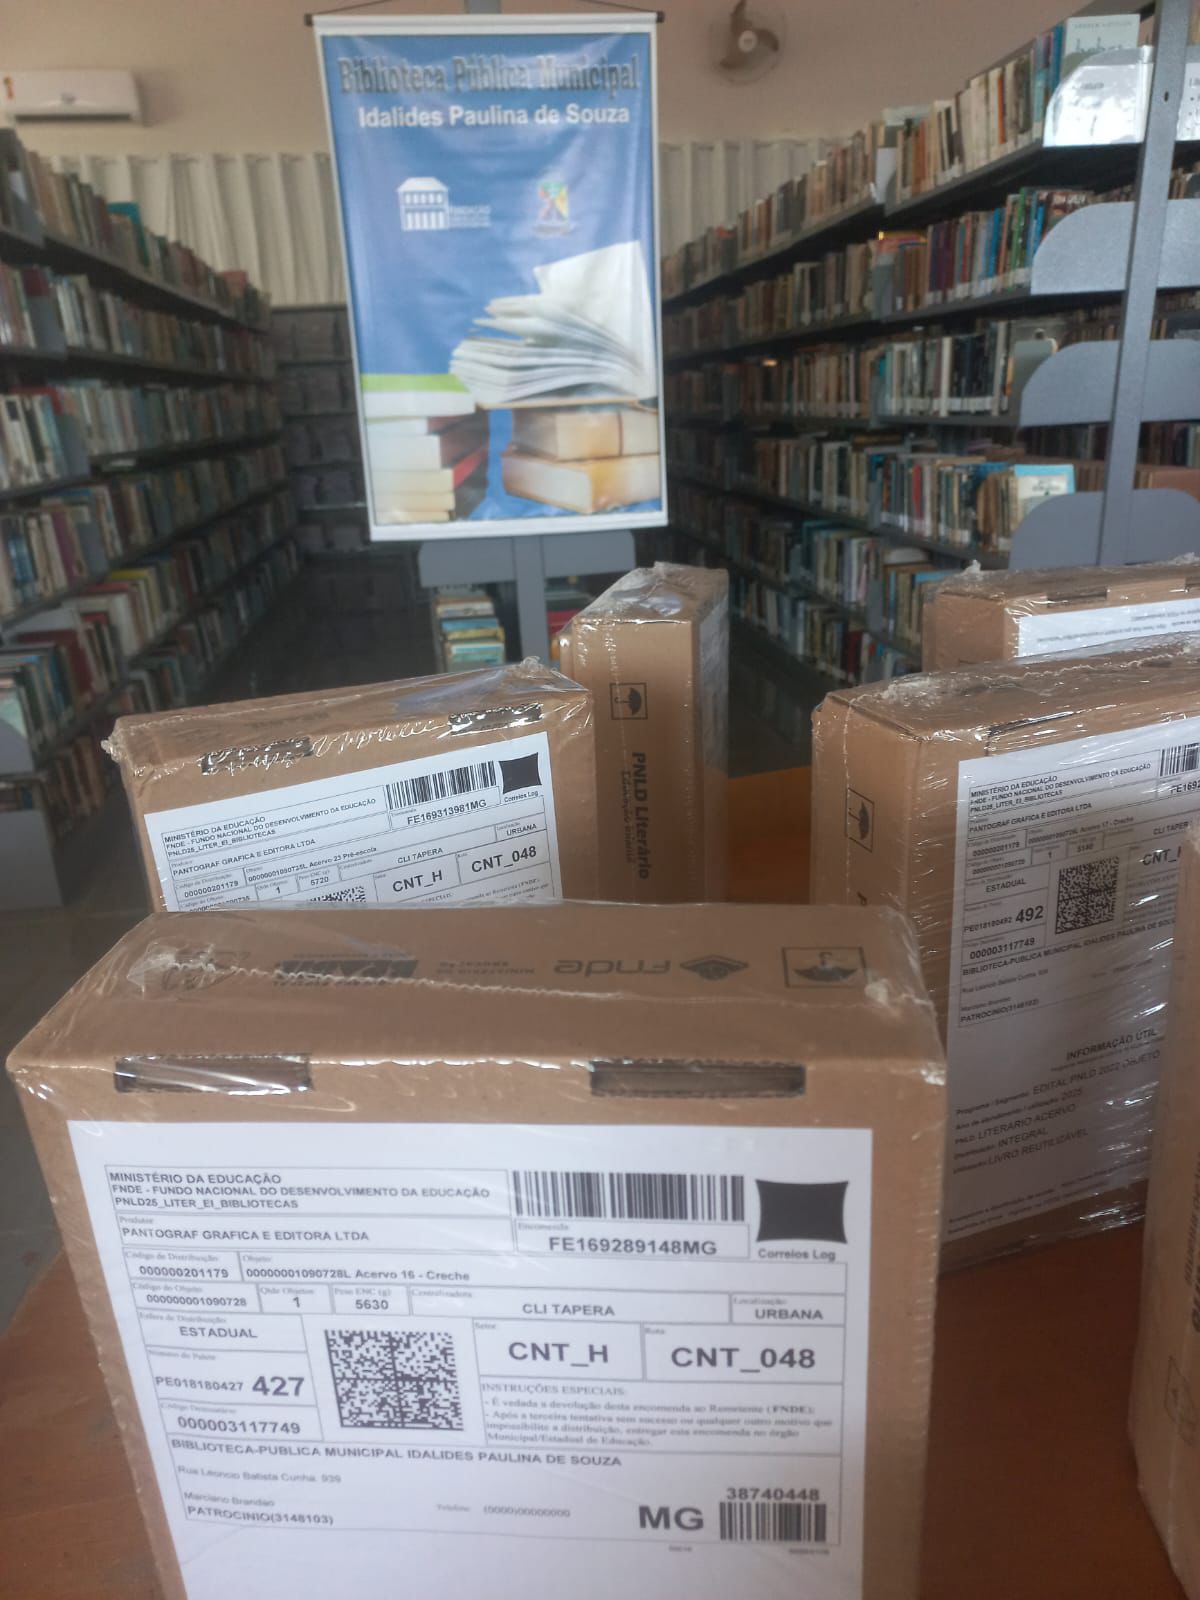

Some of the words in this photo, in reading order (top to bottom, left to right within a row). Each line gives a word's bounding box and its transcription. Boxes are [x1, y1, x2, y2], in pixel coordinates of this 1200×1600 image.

[338, 56, 448, 94] Biblioteca
[454, 54, 532, 93] Pública
[538, 54, 640, 99] Municipal
[359, 106, 443, 128] Idalides
[450, 105, 528, 126] Paulina
[534, 105, 560, 123] de
[566, 104, 630, 123] Souza
[631, 752, 648, 802] PNLD
[503, 791, 526, 803] Correios
[527, 789, 538, 798] Log
[406, 799, 486, 825] FE169313981MG
[164, 827, 209, 843] MINISTÉRIO
[223, 815, 265, 831] EDUCAÇÃO
[191, 834, 215, 844] FUNDO
[216, 826, 252, 838] NACIONAL
[633, 806, 651, 880] Literário
[173, 860, 220, 876] PANTOGRAF
[263, 843, 294, 855] EDITORA
[296, 838, 315, 847] LTDA
[412, 847, 442, 860] TAPERA
[391, 869, 443, 895] CNT_H
[470, 845, 537, 875] CNT_048
[985, 877, 1026, 892] ESTADUAL
[1015, 904, 1043, 924] 492
[108, 1170, 183, 1184] MINISTÉRIO
[185, 1174, 204, 1184] DA
[207, 1172, 282, 1186] EDUCAÇÃO
[111, 1184, 142, 1193] FNDE
[152, 1185, 193, 1195] FUNDO
[195, 1186, 256, 1196] NACIONAL
[258, 1186, 277, 1196] DO
[280, 1185, 398, 1197] DESENVOLVIMENTO
[401, 1187, 418, 1197] DA
[421, 1185, 490, 1199] EDUCAÇÃO
[114, 1196, 300, 1211] PNLD25_LITER_EI_BIBLIOTECAS
[121, 1227, 199, 1239] PANTOGRAF
[201, 1230, 259, 1240] GRAFICA
[262, 1231, 271, 1239] E
[274, 1230, 331, 1241] EDITORA
[334, 1230, 369, 1241] LTDA
[548, 1236, 716, 1256] FE169289148MG
[757, 1247, 809, 1259] Correios
[813, 1248, 835, 1262] Log
[138, 1265, 229, 1278] 000000201179
[245, 1267, 350, 1279] 00000001090728L
[354, 1269, 398, 1279] Acervo
[400, 1270, 415, 1279] 16
[425, 1270, 470, 1280] Creche
[146, 1294, 247, 1306] 000000001090728
[292, 1296, 301, 1308] 1
[354, 1298, 389, 1310] 5630
[522, 1303, 547, 1314] CLI
[551, 1303, 615, 1316] TAPERA
[754, 1308, 823, 1320] URBANA
[178, 1326, 258, 1338] ESTADUAL
[507, 1341, 610, 1367] CNT_H
[670, 1345, 816, 1374] CNT_048
[154, 1376, 245, 1391] PE018180427
[249, 1375, 308, 1397] 427
[481, 1381, 559, 1394] INSTRUÇÕES
[176, 1416, 301, 1434] 000003117749
[170, 1438, 321, 1457] BIBLIOTECA-PUBLICA
[323, 1446, 403, 1459] MUNICIPAL
[406, 1449, 473, 1461] IDALIDES
[477, 1451, 542, 1463] PAULINA
[545, 1454, 566, 1464] DE
[570, 1454, 622, 1466] SOUZA
[176, 1464, 199, 1475] Rua
[726, 1485, 820, 1503] 38740448
[186, 1504, 334, 1524] PATROCINIO(3148103)
[638, 1504, 704, 1532] MG
